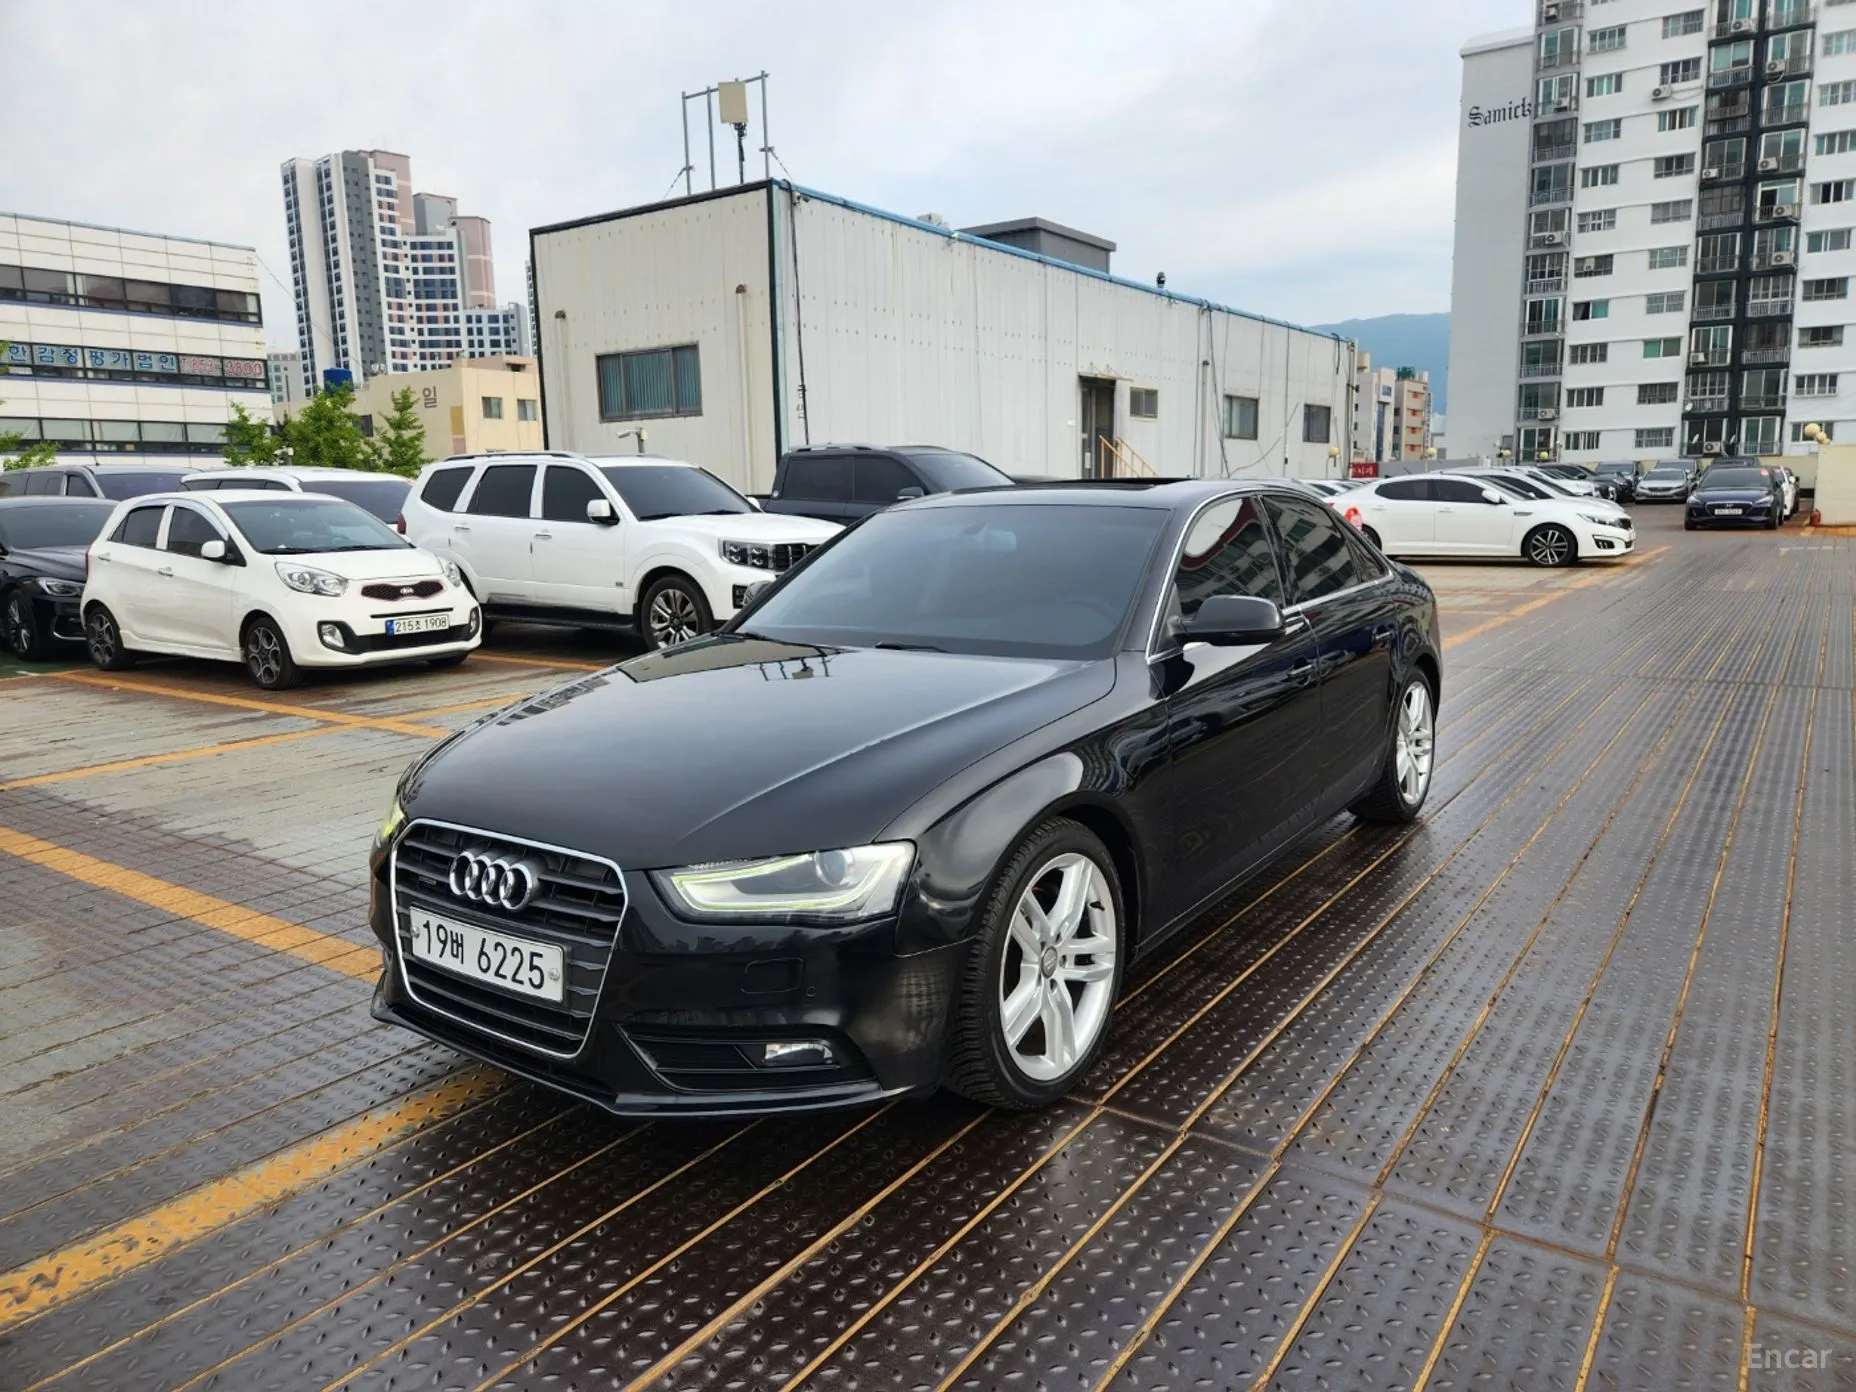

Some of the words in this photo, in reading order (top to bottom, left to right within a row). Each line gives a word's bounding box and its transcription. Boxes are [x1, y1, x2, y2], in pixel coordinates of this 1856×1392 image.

[1467, 96, 1532, 128] Samick
[422, 385, 438, 408] 일
[422, 919, 464, 965] 19버
[477, 937, 545, 990] 6225
